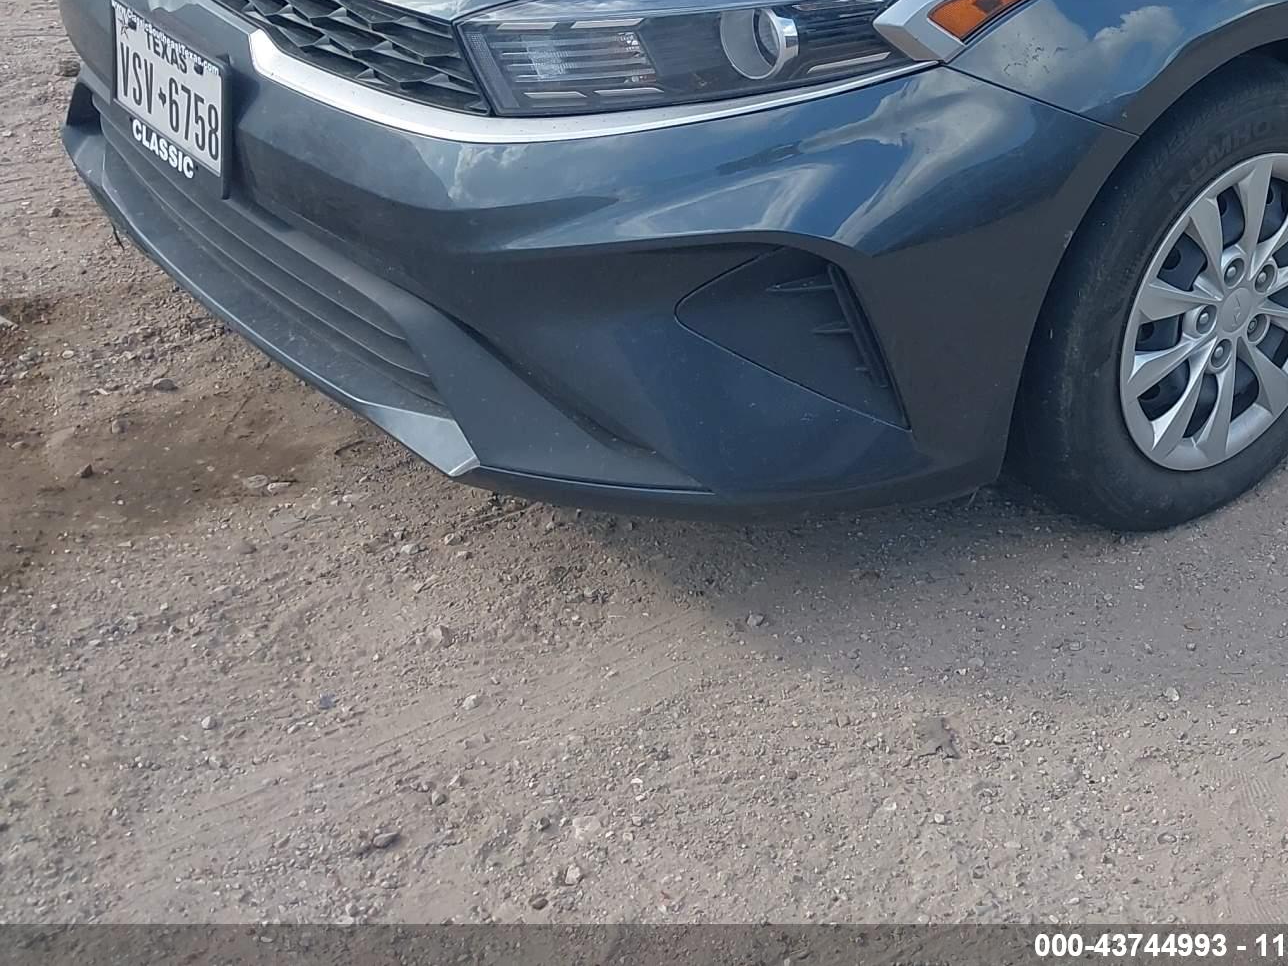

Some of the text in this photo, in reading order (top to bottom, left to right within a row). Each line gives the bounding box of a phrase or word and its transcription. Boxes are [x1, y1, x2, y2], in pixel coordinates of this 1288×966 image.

[147, 33, 188, 74] TEXAS
[120, 41, 220, 161] VSV 6758
[131, 117, 195, 179] CLASSIC
